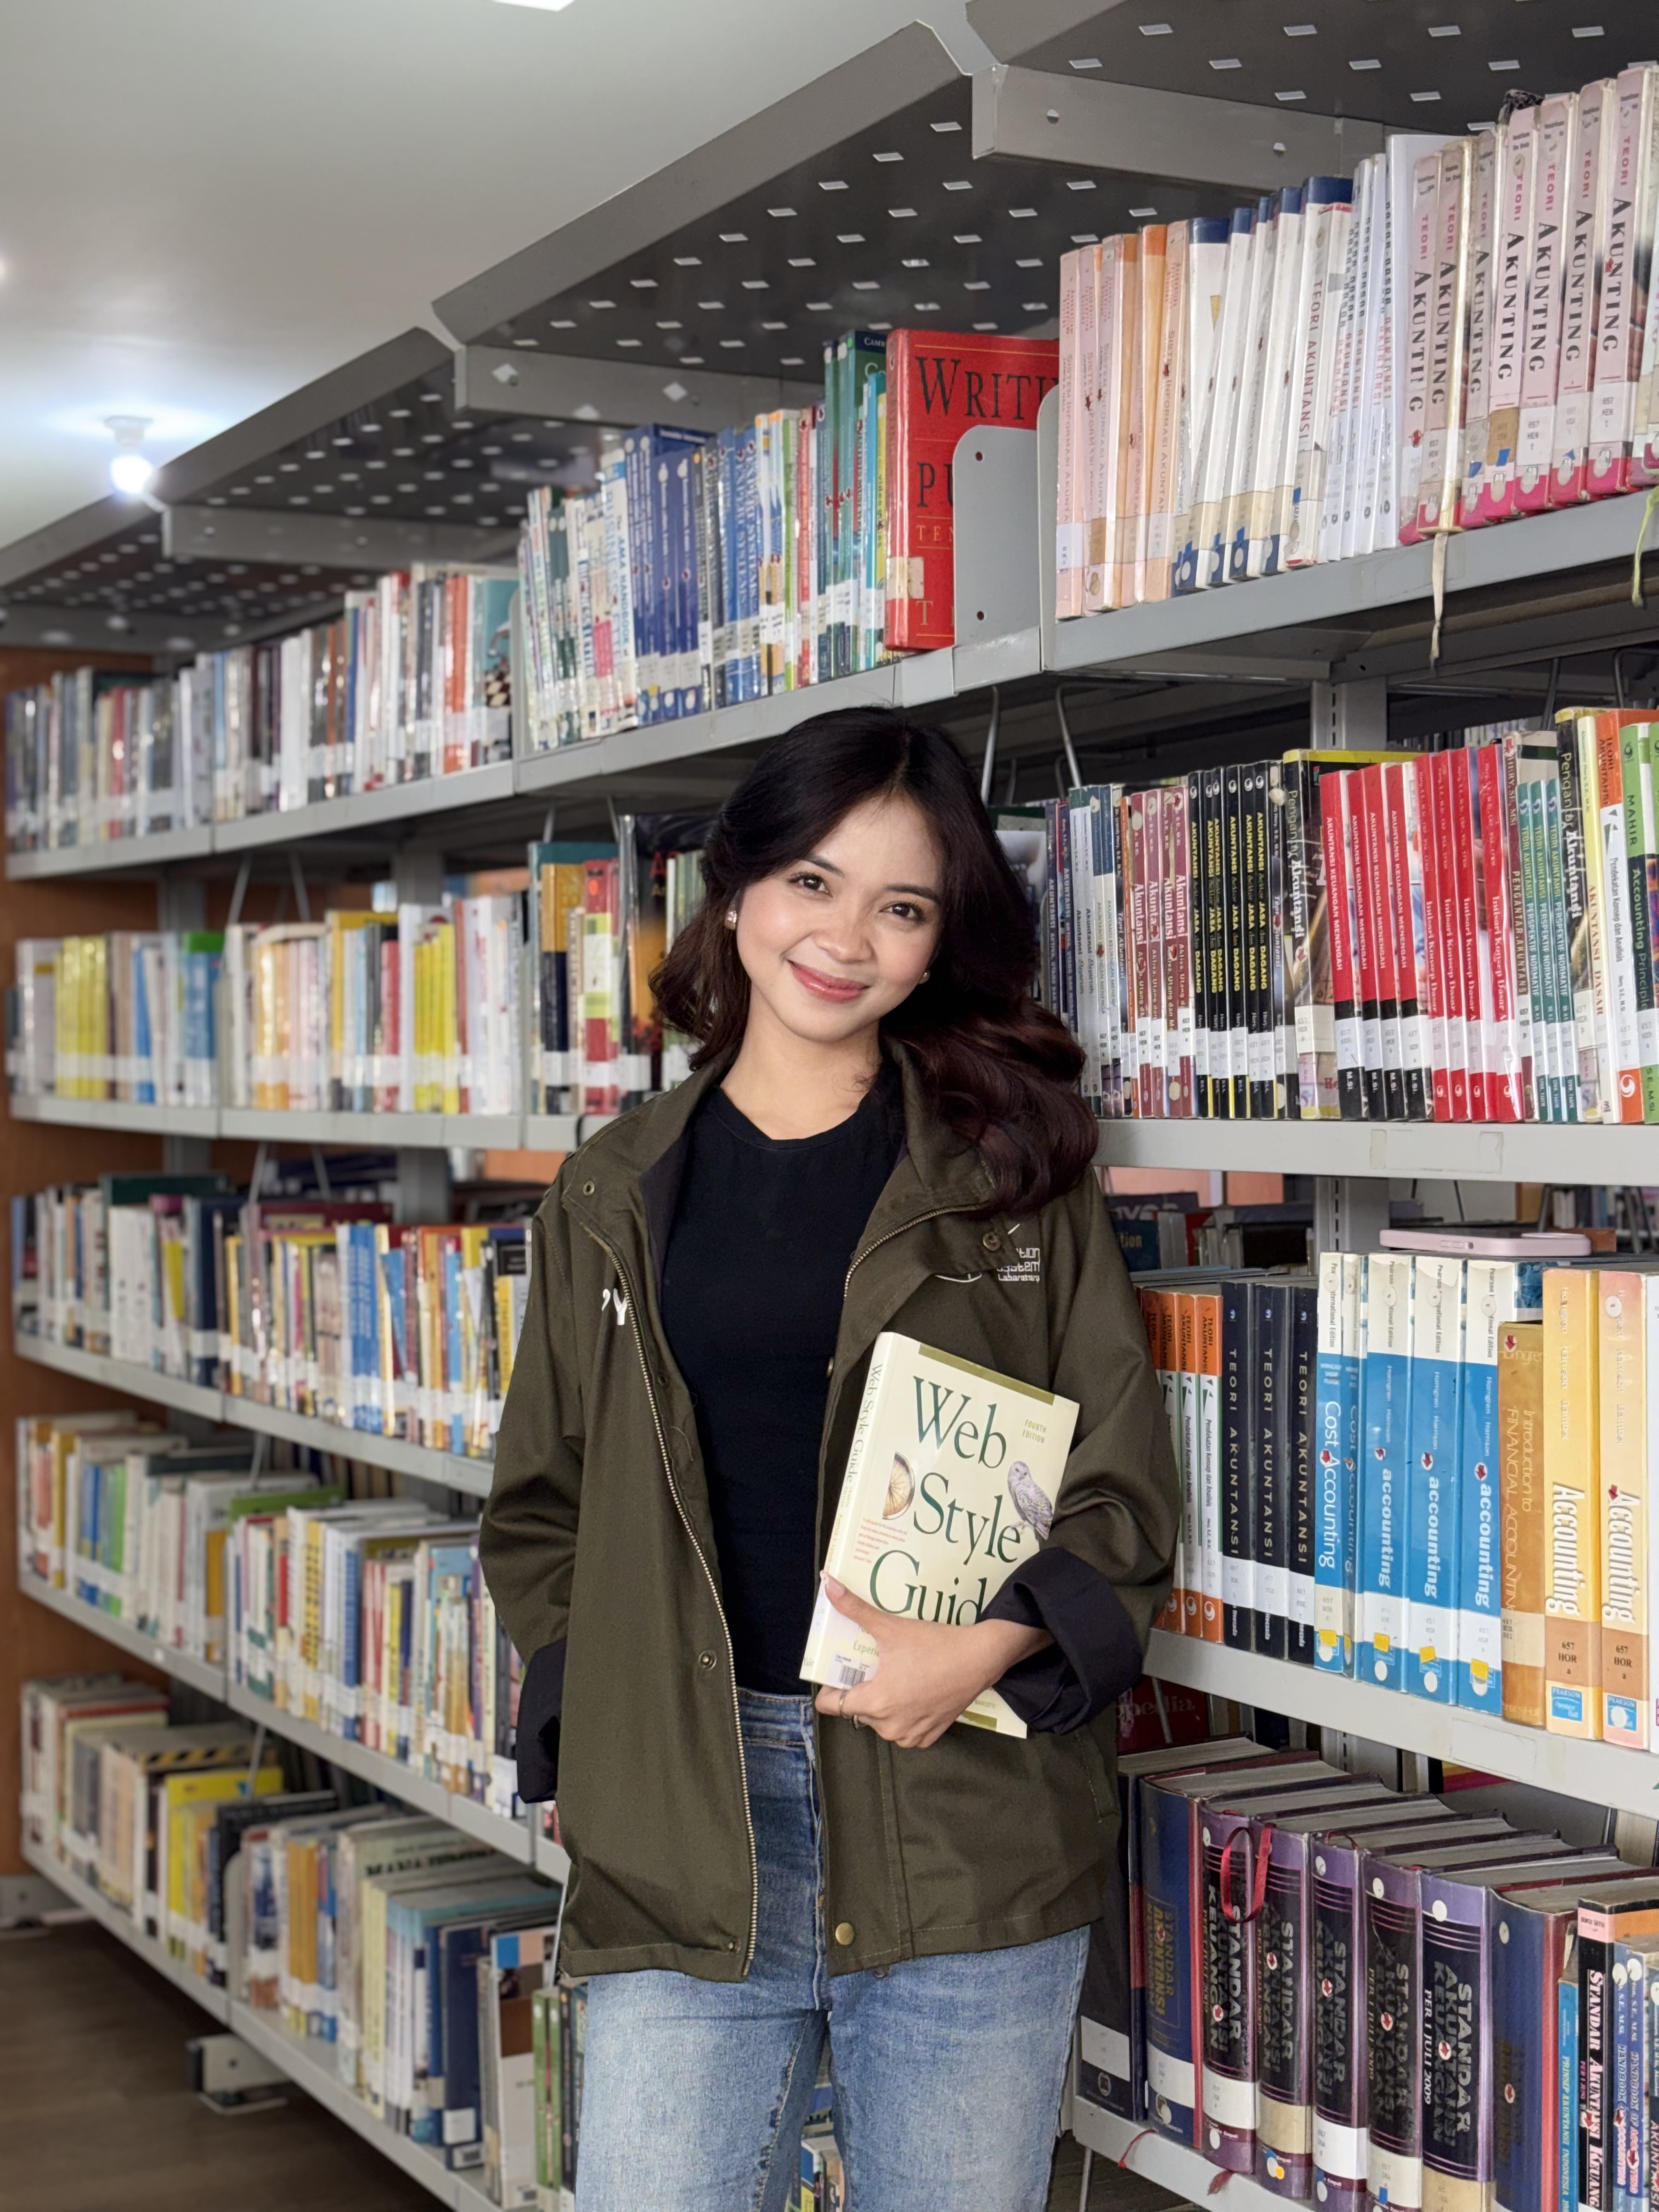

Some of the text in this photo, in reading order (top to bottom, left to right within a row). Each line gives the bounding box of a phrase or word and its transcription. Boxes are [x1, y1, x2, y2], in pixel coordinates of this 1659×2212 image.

[1420, 215, 1429, 261] TEORI
[1498, 174, 1525, 380] TEORI AKUNTING
[1528, 164, 1558, 372] TEORI AKUNTING
[1566, 149, 1593, 362] TEORI AKUNTING
[1602, 136, 1632, 352] TEORI AKUNTING
[1431, 204, 1457, 404] TEORI AKUNTING
[1470, 250, 1489, 394] AKUNTING
[1299, 340, 1317, 445] AKUNTANSI
[620, 575, 629, 644] HANDBOOK
[1599, 738, 1609, 805] AKUNTANSI
[1628, 795, 1637, 847] MAHIR
[1165, 878, 1176, 940] Akuntansi
[1176, 874, 1187, 937] Akuntansi
[1291, 860, 1305, 938] Akuntansi
[1327, 817, 1342, 971] AKUNTANSI KEUANGAN MENENGAH
[1352, 815, 1367, 970] AKUNTANSI KEUANGAN MENENGAH
[1370, 812, 1385, 969] AKUNTANSI KEUANGAN MENENGAH
[1392, 810, 1407, 968] AKUNTANSI KEUANGAN MENENGAH
[1565, 830, 1581, 919] Akuntansi
[1135, 884, 1146, 945] Akuntansi
[1539, 903, 1549, 952] PERSPEKTIF
[1555, 902, 1565, 952] PERSPEKTIF
[1589, 884, 1604, 1016] AKUNTANSI DASAR
[1632, 868, 1648, 1011] Accounting Principle
[1465, 939, 1474, 979] Konsep
[1493, 936, 1504, 977] Konsep
[1530, 954, 1538, 997] NORMATIF
[1543, 954, 1552, 997] NORMATIF
[1558, 953, 1568, 997] NORMATIF
[1497, 980, 1506, 1012] Dasar
[998, 1273, 1040, 1285] Laboratory
[847, 1364, 883, 1483] Web Style Guide
[913, 1375, 1007, 1469] Web
[1022, 1429, 1046, 1444] EDITION
[1024, 1418, 1048, 1434] FOURTH
[1229, 1348, 1239, 1555] TEORI AKUNTANSI
[1264, 1348, 1273, 1557] TEORI AKUNTANSI
[1298, 1351, 1308, 1563] TEORI AKUNTANSI
[1324, 1401, 1341, 1448] Cost
[1522, 1410, 1536, 1513] Introduction to
[913, 1472, 1022, 1566] Style
[1379, 1468, 1393, 1589] accounting
[1425, 1476, 1442, 1599] accounting
[1475, 1483, 1494, 1609] accounting
[1505, 1408, 1519, 1610] FINANCIAL ACCOUNTIN
[870, 1549, 989, 1626] Guid
[1545, 1482, 1587, 1617] Accounting
[1601, 1491, 1641, 1624] Accounting
[1558, 1652, 1577, 1663] HOR
[1561, 1641, 1575, 1650] 657
[1613, 1656, 1633, 1668] HOR
[1615, 1645, 1629, 1654] 657
[1553, 1688, 1581, 1699] PEARSON
[1229, 1905, 1241, 2039] STANDAR
[1589, 1970, 1604, 2051] STANDAR
[1424, 2030, 1432, 2067] JULI
[1457, 1982, 1472, 2133] STANDAR
[1618, 2044, 1627, 2101] HANDBOOK
[1630, 2051, 1639, 2111] HANDBOOK
[1424, 2070, 1432, 2106] 2009
[1589, 2144, 1603, 2208] KEUANG
